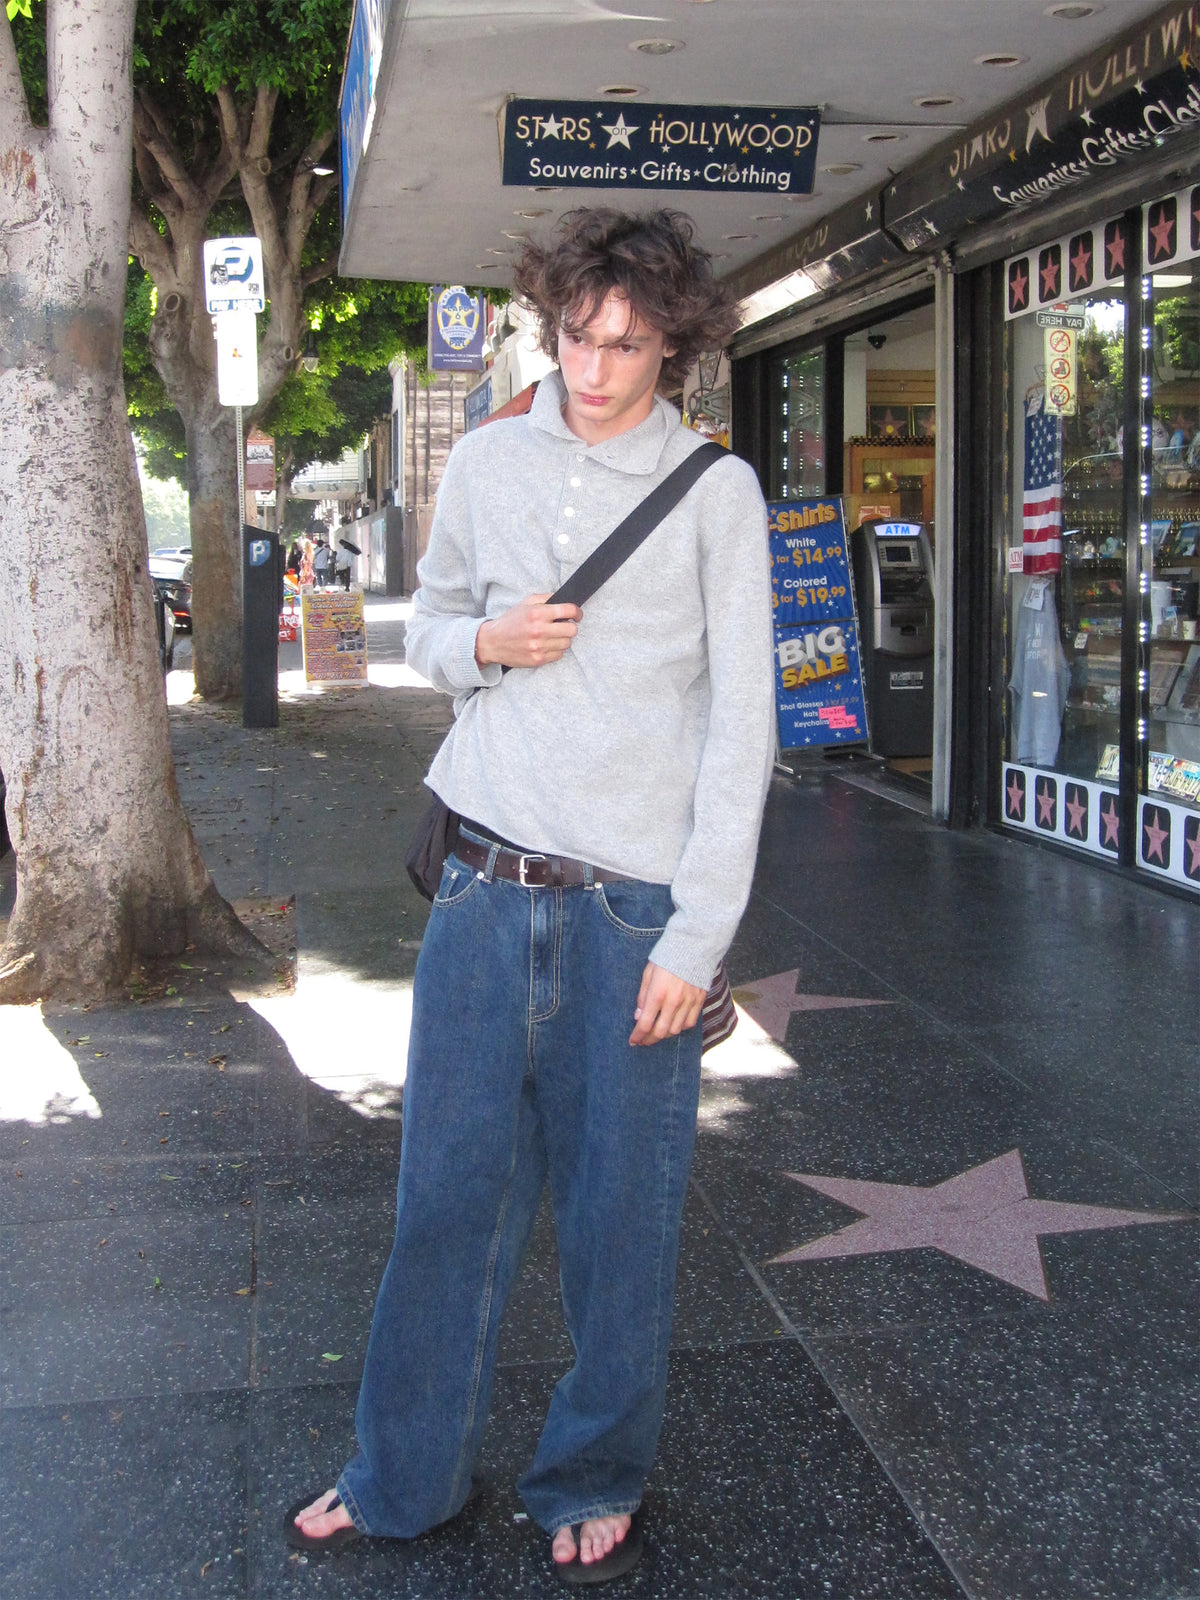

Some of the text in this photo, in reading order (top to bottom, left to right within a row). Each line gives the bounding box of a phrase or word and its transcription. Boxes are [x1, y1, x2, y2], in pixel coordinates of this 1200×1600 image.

[611, 127, 628, 137] on
[649, 119, 812, 149] HOLLYWOOD
[528, 157, 792, 191] Souvenirs Gifts Clothing
[992, 161, 1091, 208] Souvenirs
[1081, 127, 1150, 166] Gifts
[768, 503, 838, 535] -Shirts
[885, 525, 910, 535] ATM
[252, 543, 265, 562] P
[785, 537, 817, 548] White
[776, 555, 789, 563] for
[792, 546, 842, 568] $14.99
[783, 575, 828, 589] Colored
[780, 595, 794, 603] for
[796, 586, 846, 607] $19.99
[778, 626, 847, 669] BIG
[781, 653, 849, 691] SALE
[780, 702, 796, 711] Shot
[796, 701, 824, 710] Glasses
